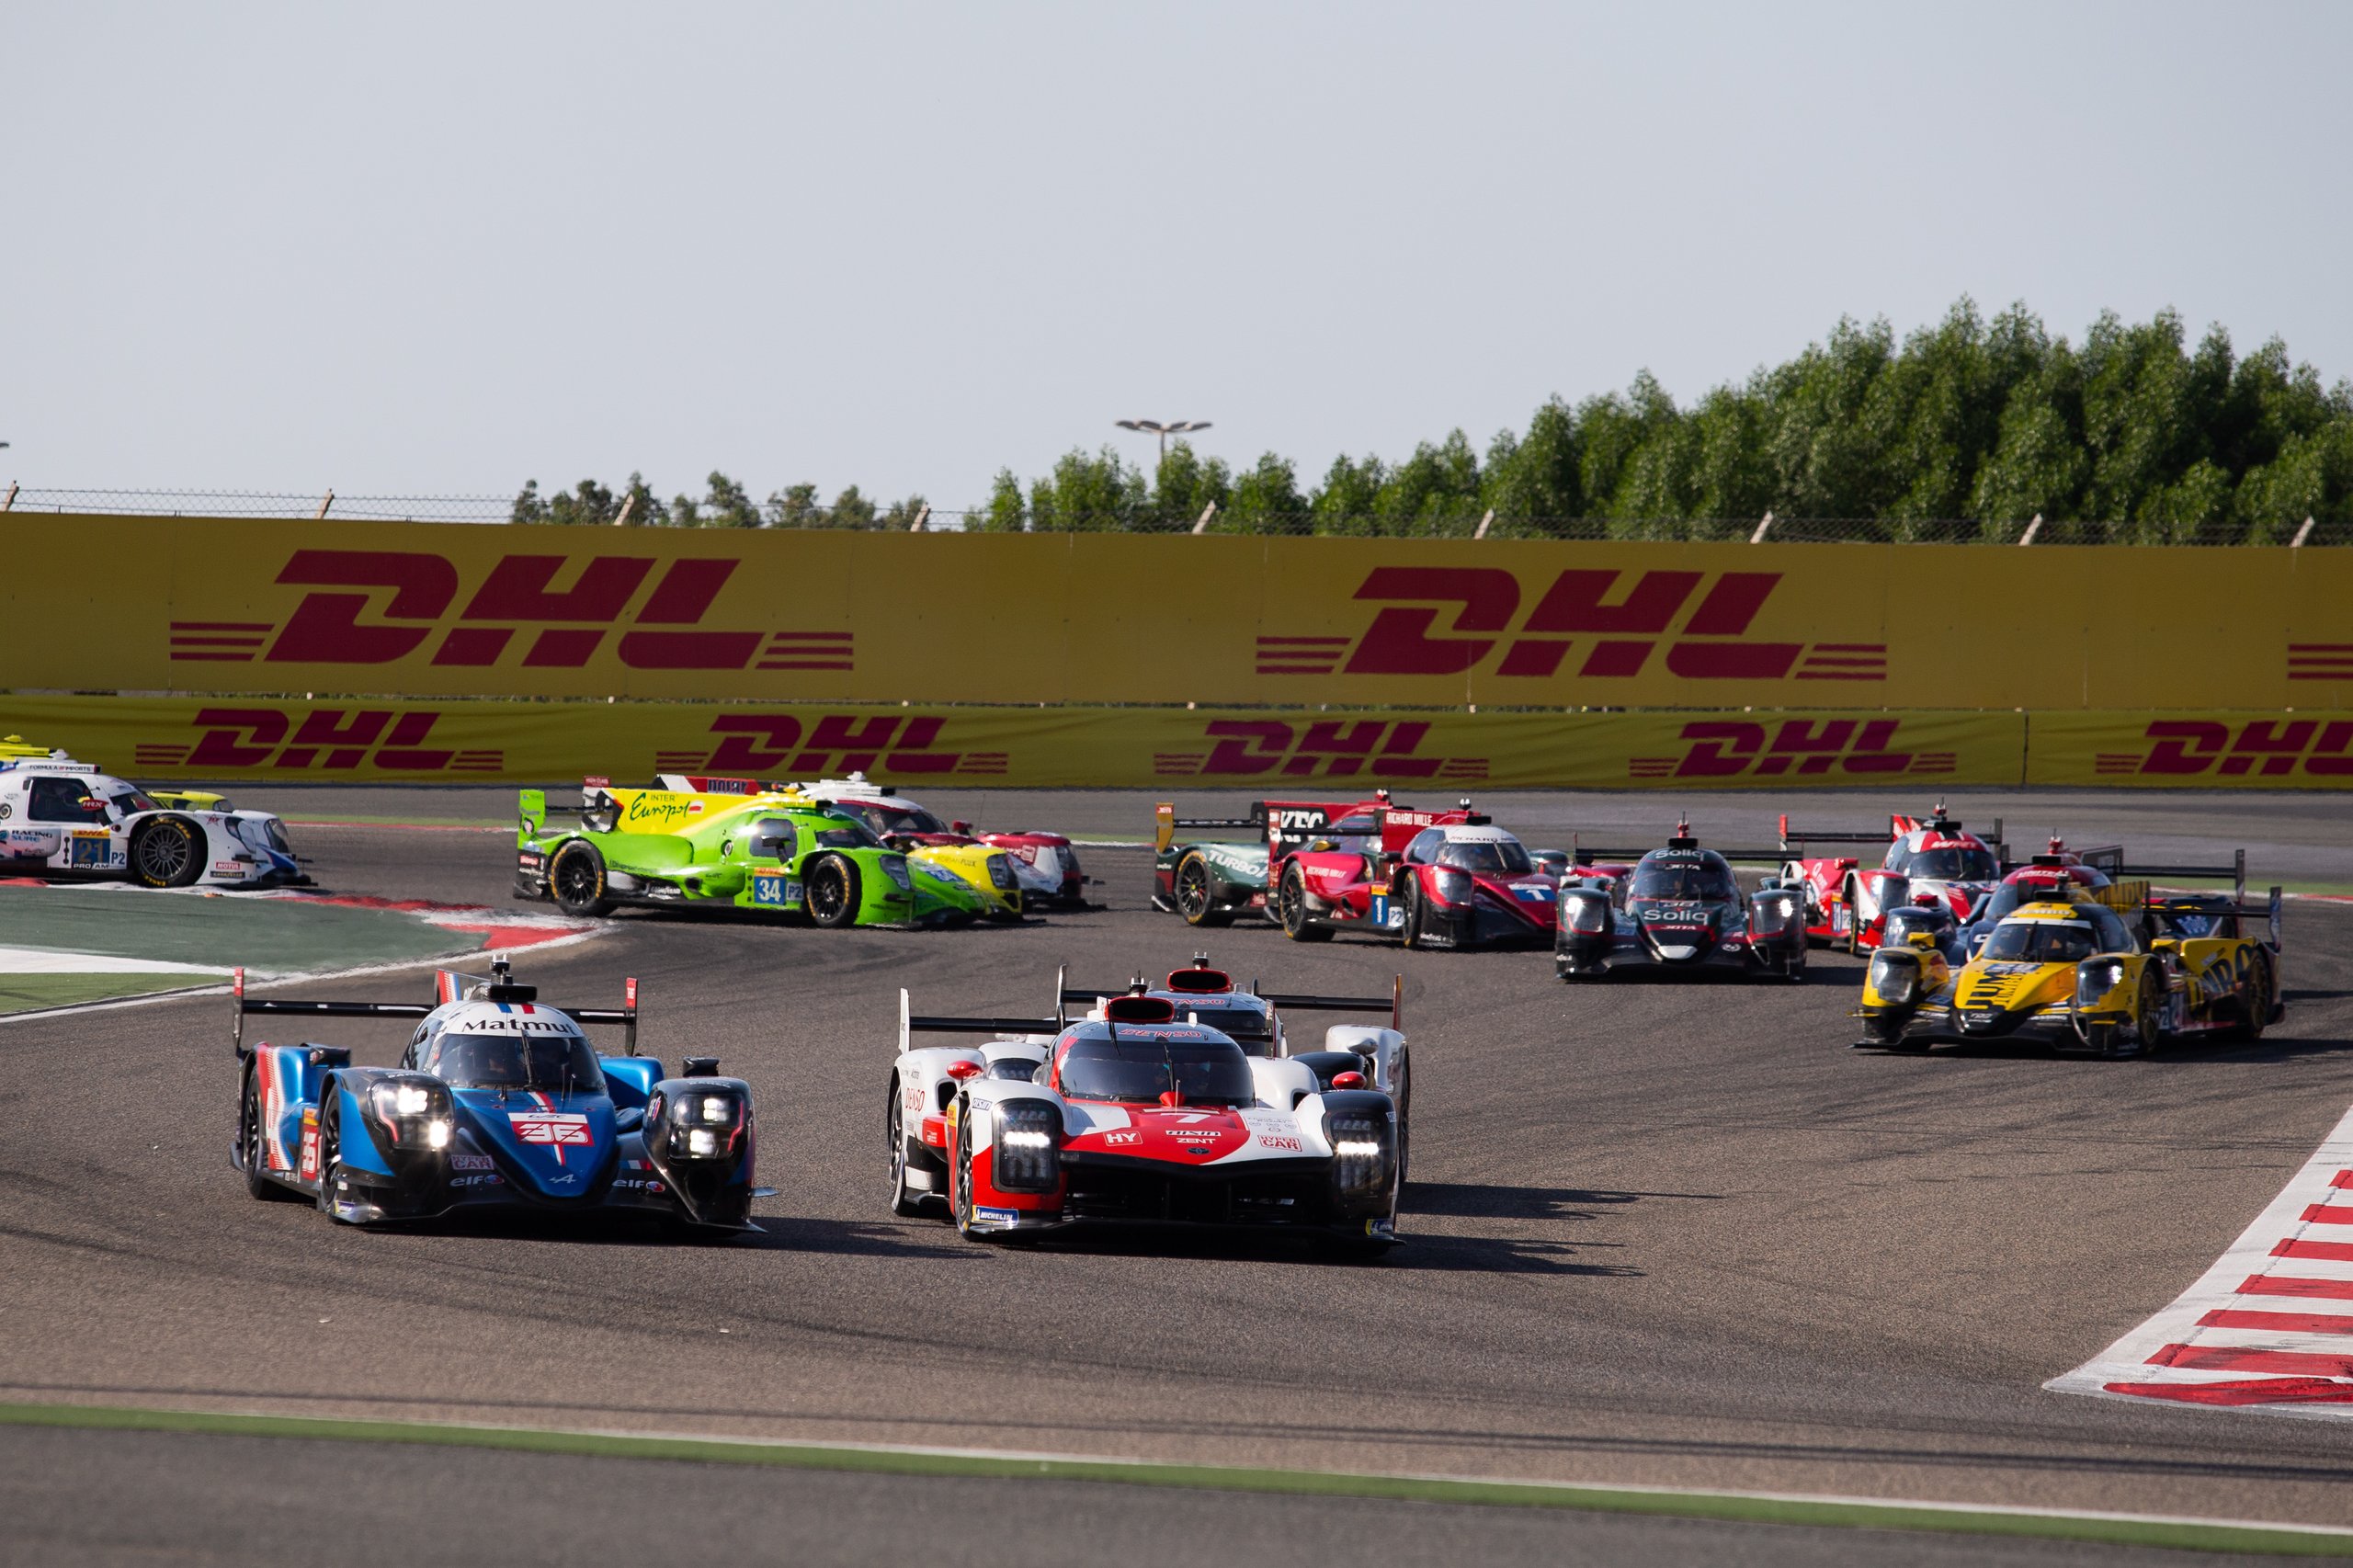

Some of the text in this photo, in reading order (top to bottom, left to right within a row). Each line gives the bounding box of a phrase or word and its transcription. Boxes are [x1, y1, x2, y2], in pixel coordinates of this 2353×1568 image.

[264, 549, 765, 669] DHL
[1343, 567, 1805, 679] DHL
[185, 709, 458, 769] DHL
[704, 714, 961, 774] DHL
[1202, 721, 1449, 777] DHL
[1674, 719, 1915, 777] DHL
[2141, 721, 2353, 775] DHL
[651, 794, 676, 802] INTER
[630, 792, 690, 824] Europol
[1386, 812, 1413, 824] RICHARD
[12, 830, 52, 838] RACING
[78, 840, 105, 864] 21
[111, 852, 126, 866] P2
[1655, 849, 1704, 862] Soliq
[758, 879, 781, 903] 34
[788, 885, 802, 898] P2
[1526, 889, 1546, 901] 1
[1375, 897, 1383, 924] 1
[1643, 908, 1709, 925] Soliq
[462, 1018, 576, 1036] Matmut
[1118, 1028, 1202, 1038] DENSO
[905, 1087, 926, 1112] DENSO
[1160, 1114, 1211, 1123] 7
[518, 1122, 589, 1143] 36
[1107, 1132, 1137, 1143] HY
[1262, 1140, 1299, 1150] CAR
[454, 1161, 494, 1170] CAR
[449, 1175, 484, 1187] elf
[612, 1178, 645, 1189] elf
[980, 1211, 1014, 1222] MICHELIN
